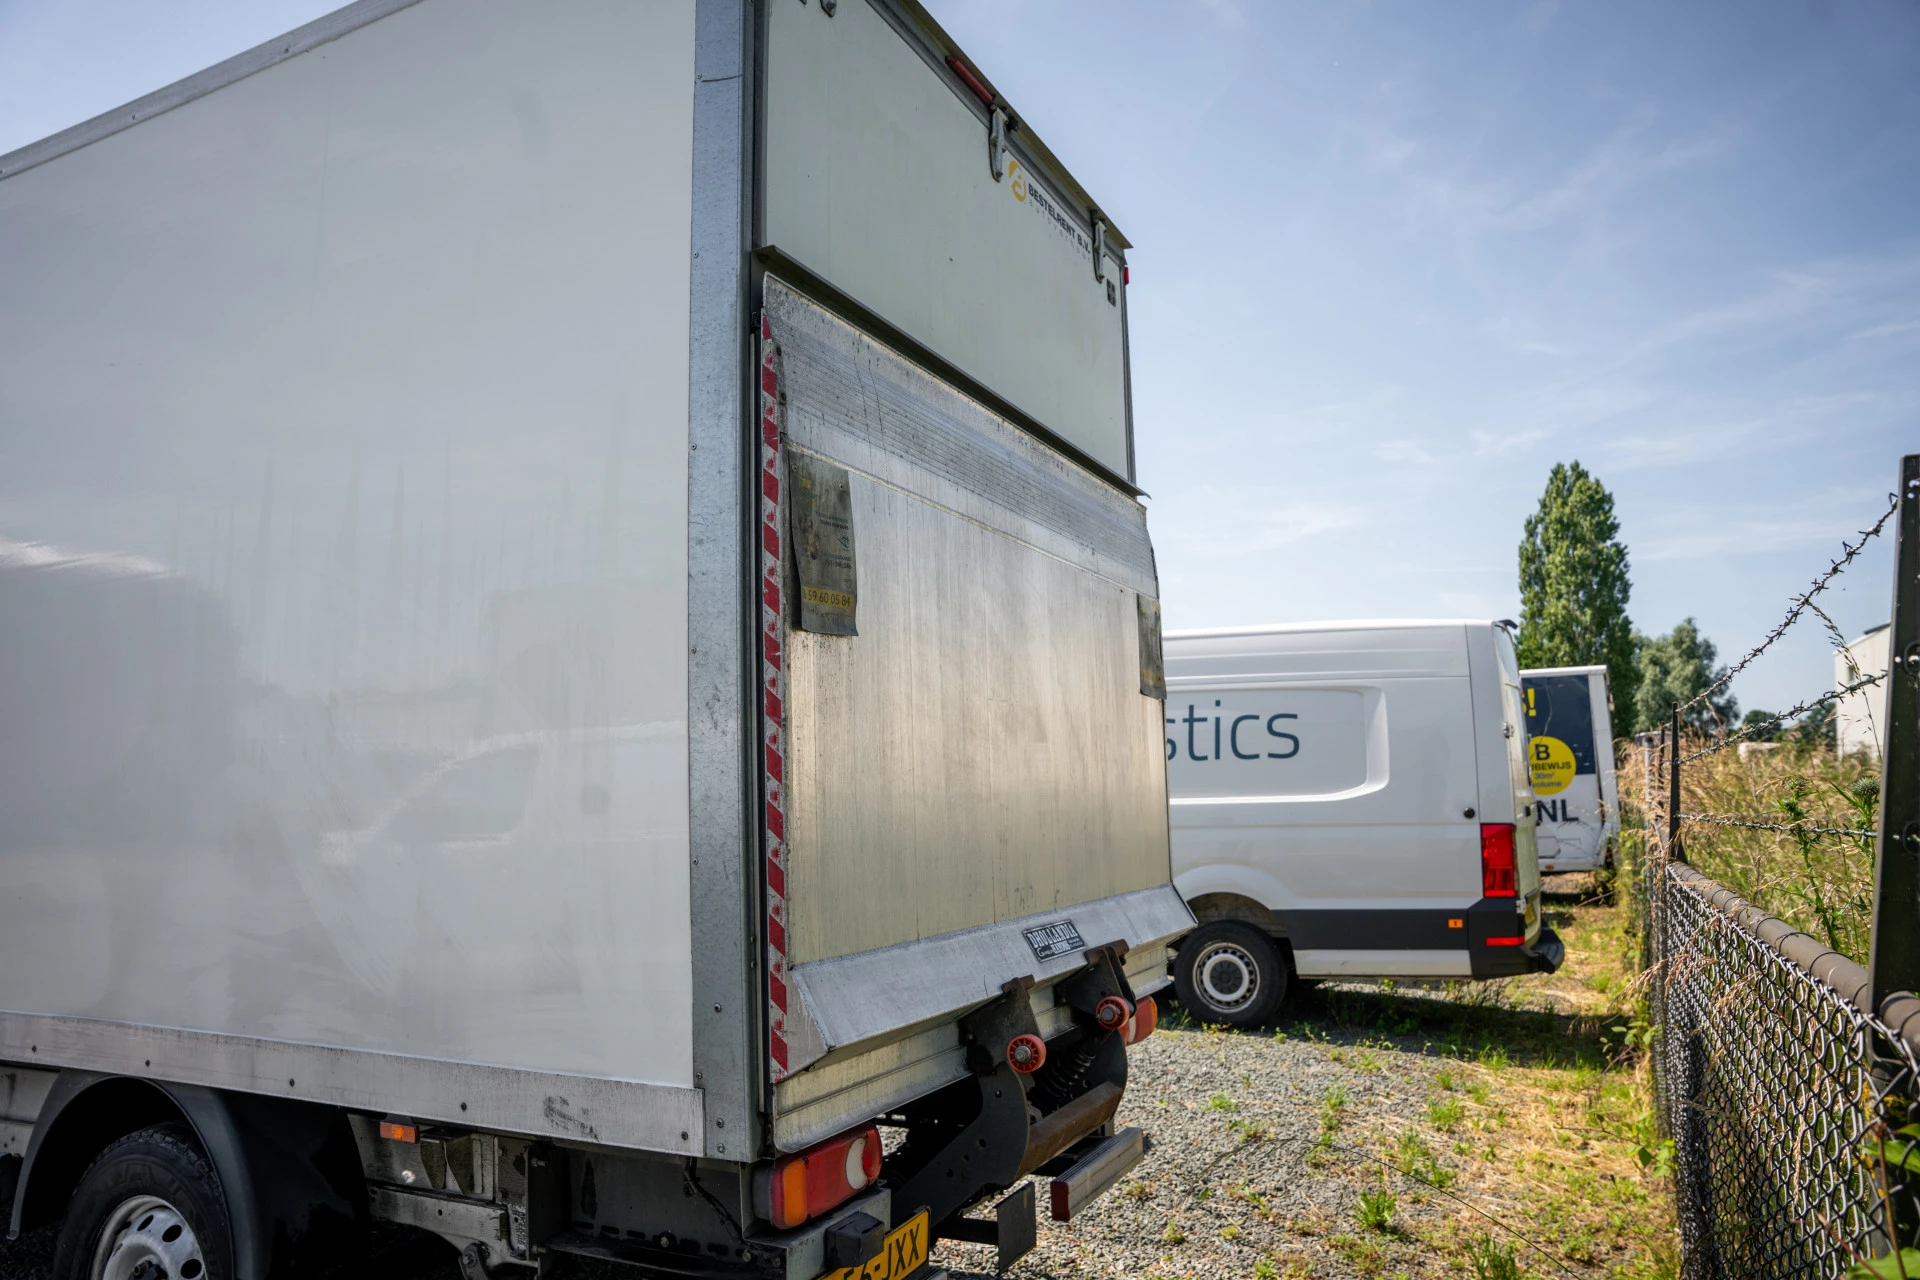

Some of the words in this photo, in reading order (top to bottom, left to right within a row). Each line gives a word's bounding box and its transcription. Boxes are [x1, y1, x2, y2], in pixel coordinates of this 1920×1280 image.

[1028, 183, 1076, 239] BESTELRENT
[1077, 234, 1091, 254] B.V.
[808, 590, 817, 601] 59
[819, 592, 829, 603] 60
[831, 594, 840, 605] 05
[842, 596, 851, 606] 84
[1535, 744, 1551, 761] B
[1027, 923, 1078, 948] DHOLLANDIA
